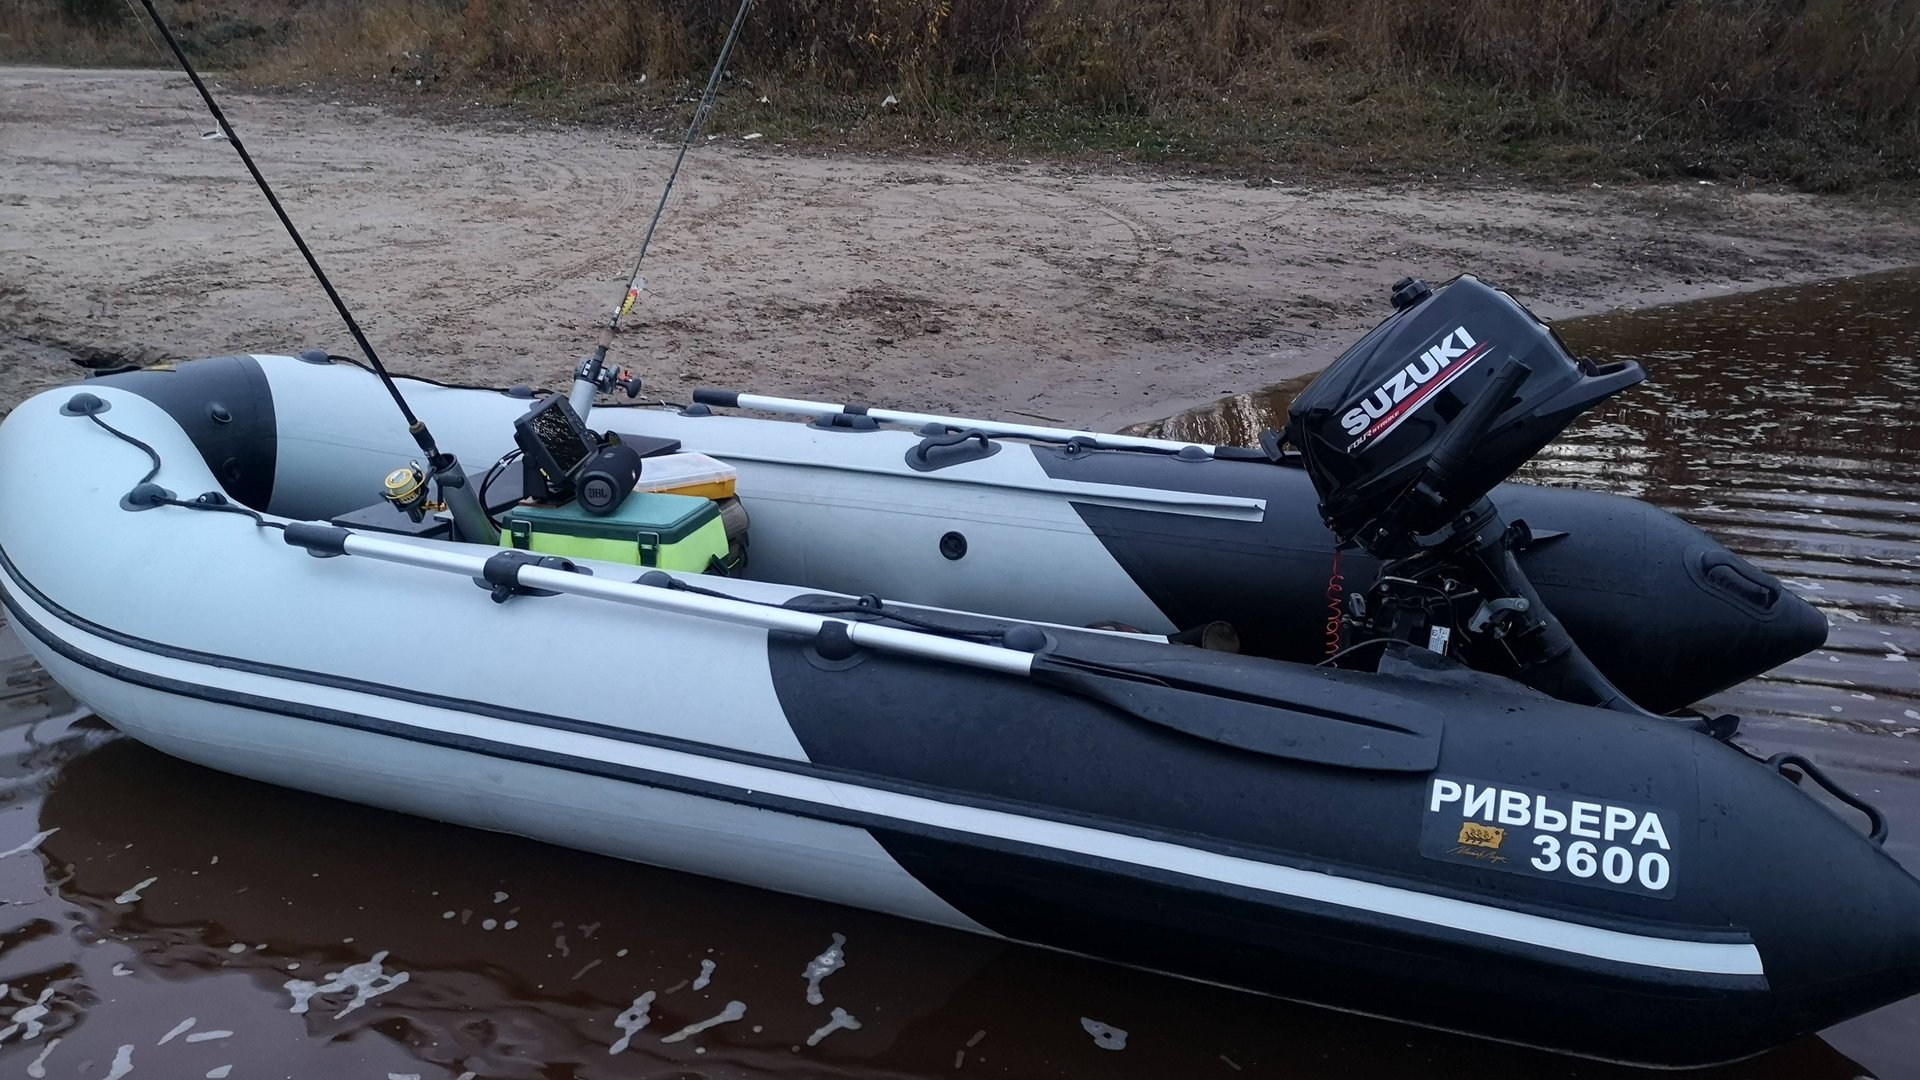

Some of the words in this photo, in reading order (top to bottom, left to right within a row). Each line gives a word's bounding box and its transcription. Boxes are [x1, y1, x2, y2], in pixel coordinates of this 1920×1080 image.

[1341, 325, 1477, 436] SUZUKI
[1347, 429, 1372, 454] FOUR
[1372, 410, 1400, 434] STROKE
[588, 487, 608, 499] JBL
[1430, 778, 1671, 850] РИВЬЕРА
[1530, 834, 1671, 890] 3600
